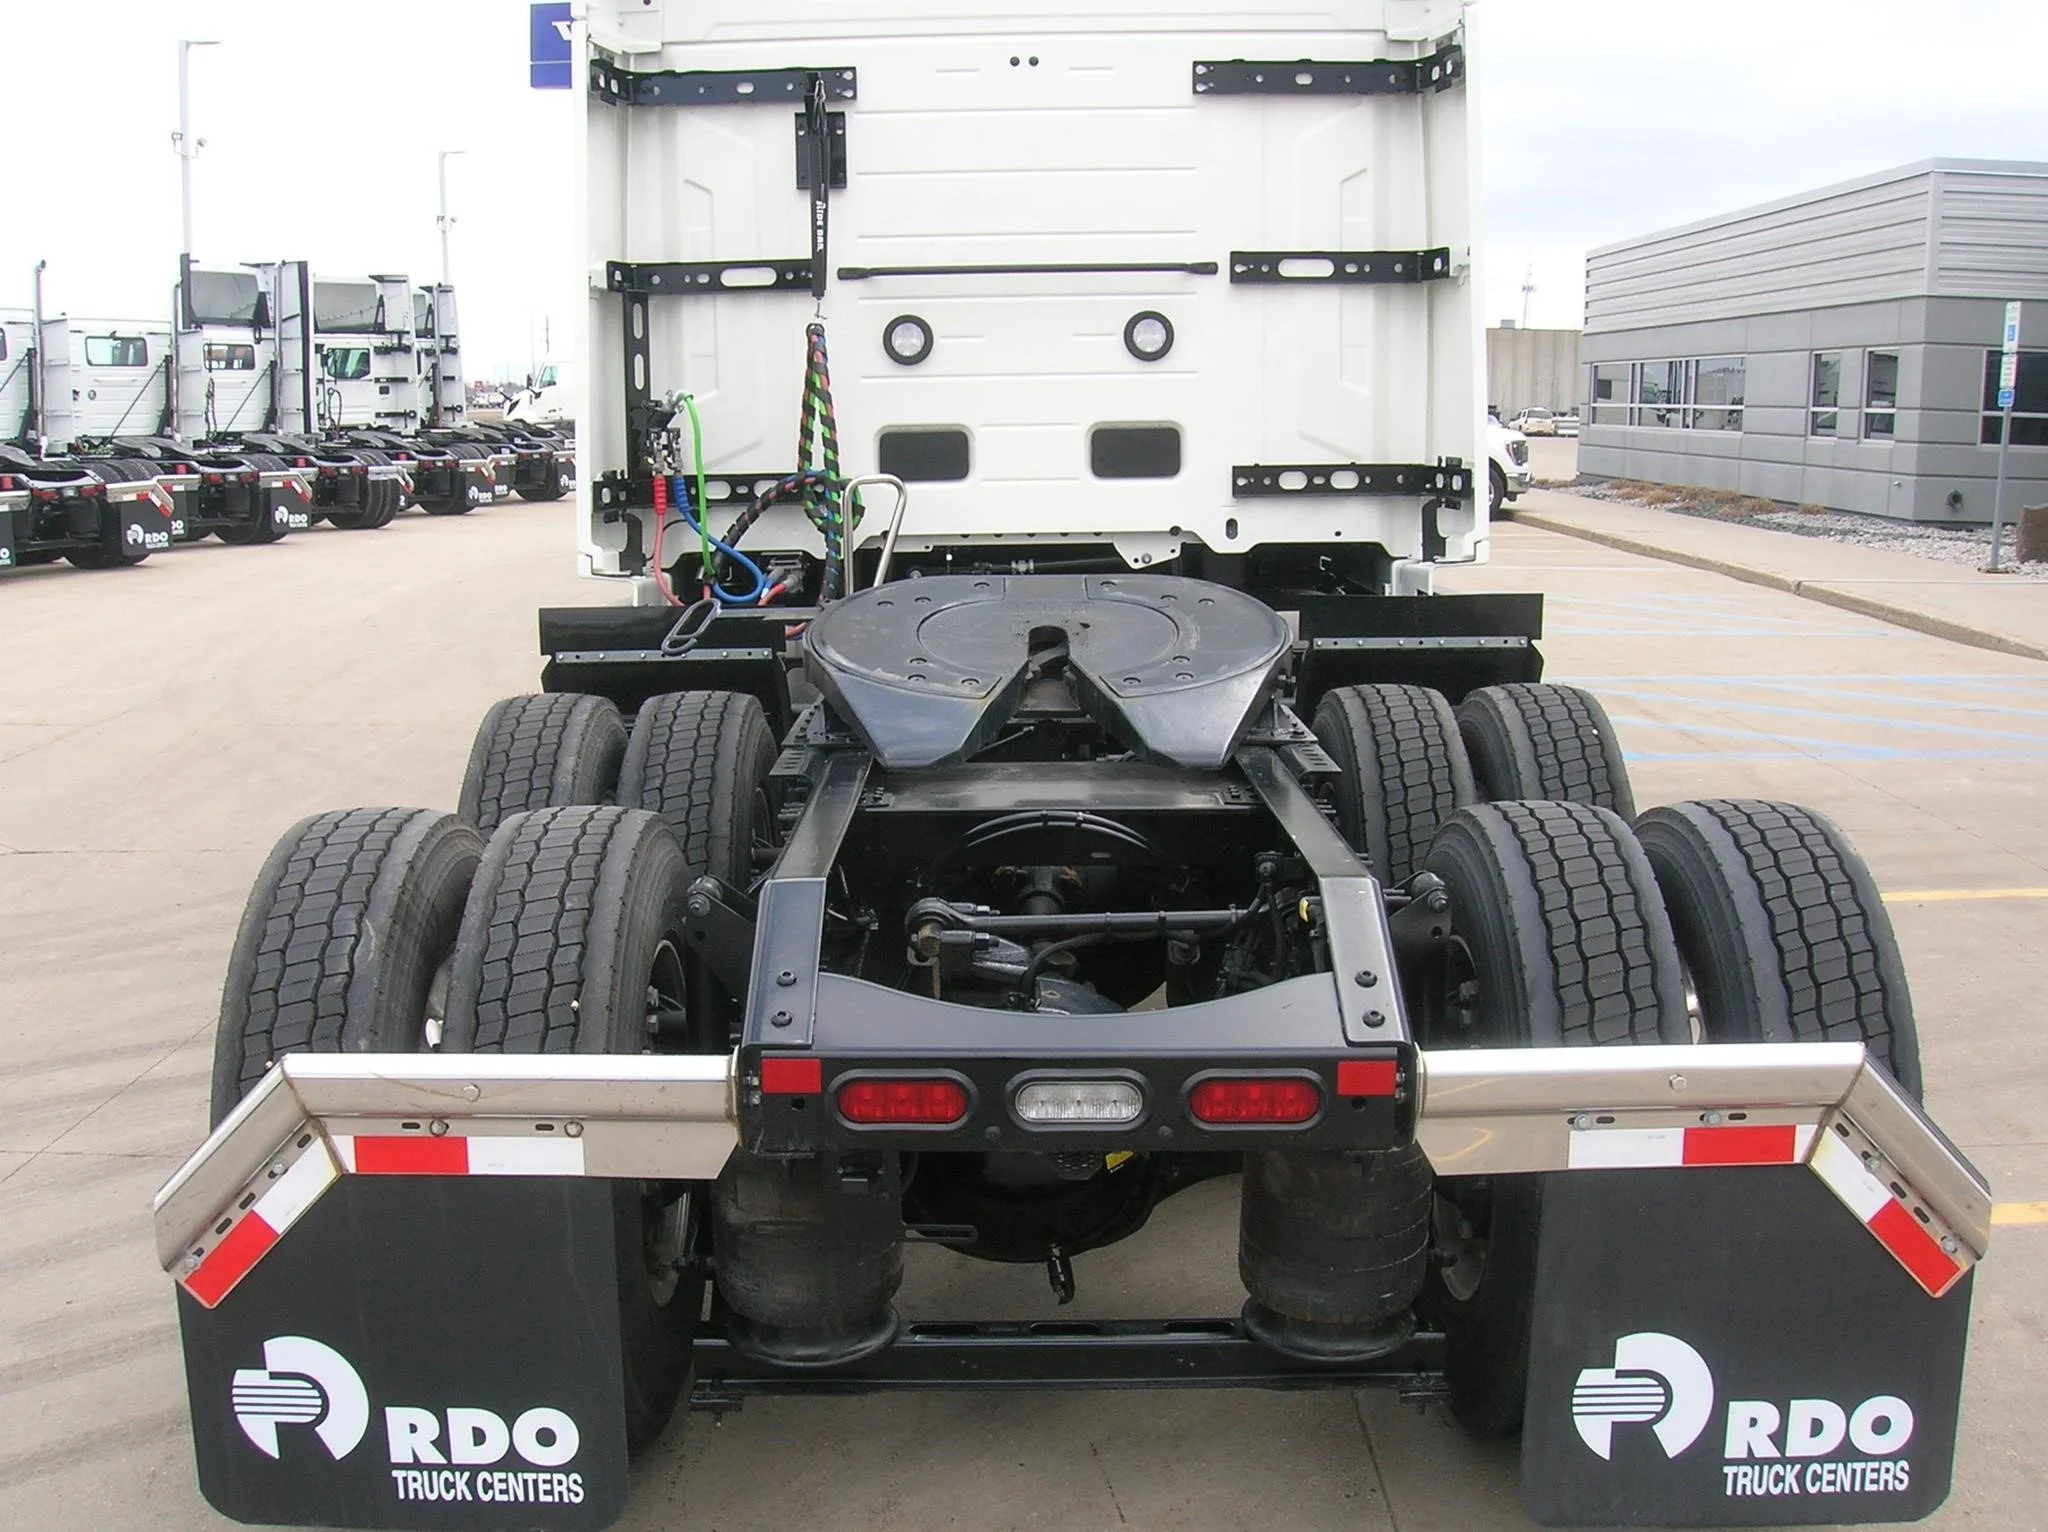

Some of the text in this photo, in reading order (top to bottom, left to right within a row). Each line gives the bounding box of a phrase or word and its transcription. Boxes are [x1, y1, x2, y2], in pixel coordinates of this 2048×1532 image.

[145, 532, 169, 543] RDO
[385, 1406, 580, 1467] RDO
[1724, 1395, 1914, 1459] RDO
[391, 1469, 585, 1504] TRUCK CENTERS
[1723, 1460, 1910, 1496] TRUCK CENTERS
